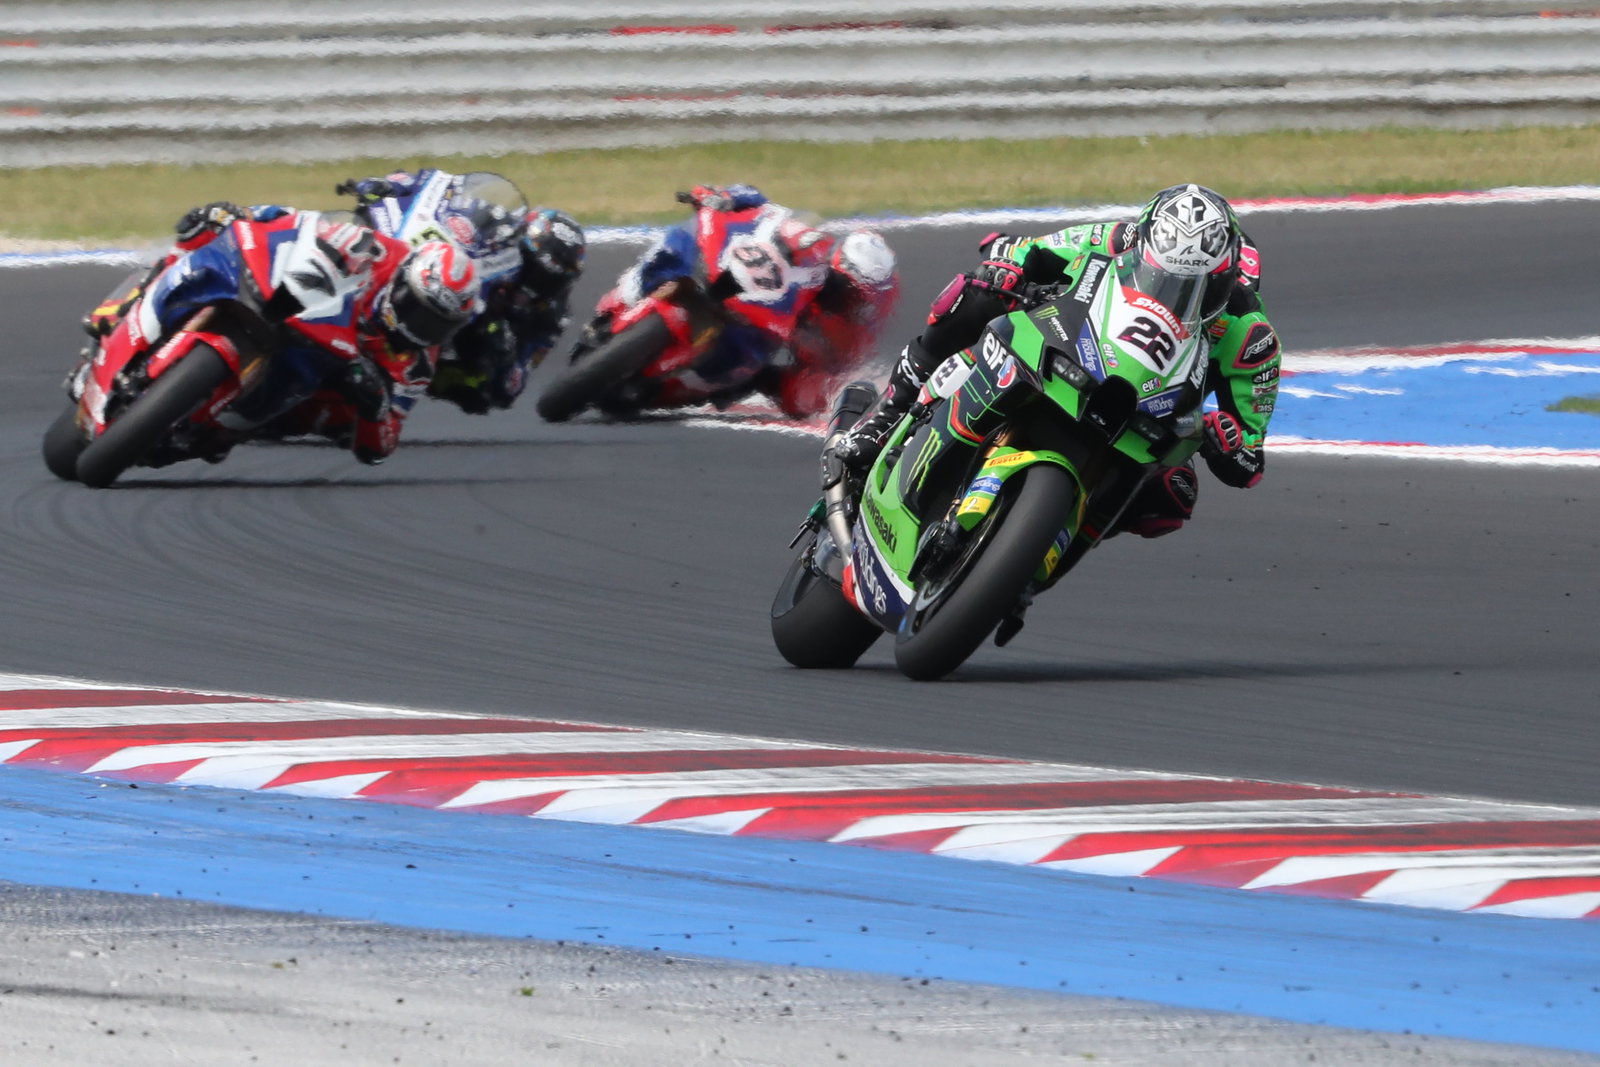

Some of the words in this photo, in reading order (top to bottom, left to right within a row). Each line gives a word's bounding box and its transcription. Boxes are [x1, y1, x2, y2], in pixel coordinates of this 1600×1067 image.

[1165, 256, 1210, 267] SHARK
[1077, 258, 1107, 304] Kawasaki
[1132, 297, 1181, 335] SHOWA
[982, 332, 1007, 370] elf
[1102, 343, 1117, 361] elf
[1116, 316, 1177, 372] 22
[1242, 332, 1275, 360] RST
[1142, 380, 1156, 393] elf
[1253, 369, 1271, 383] elf
[989, 452, 1025, 467] PIRELLI
